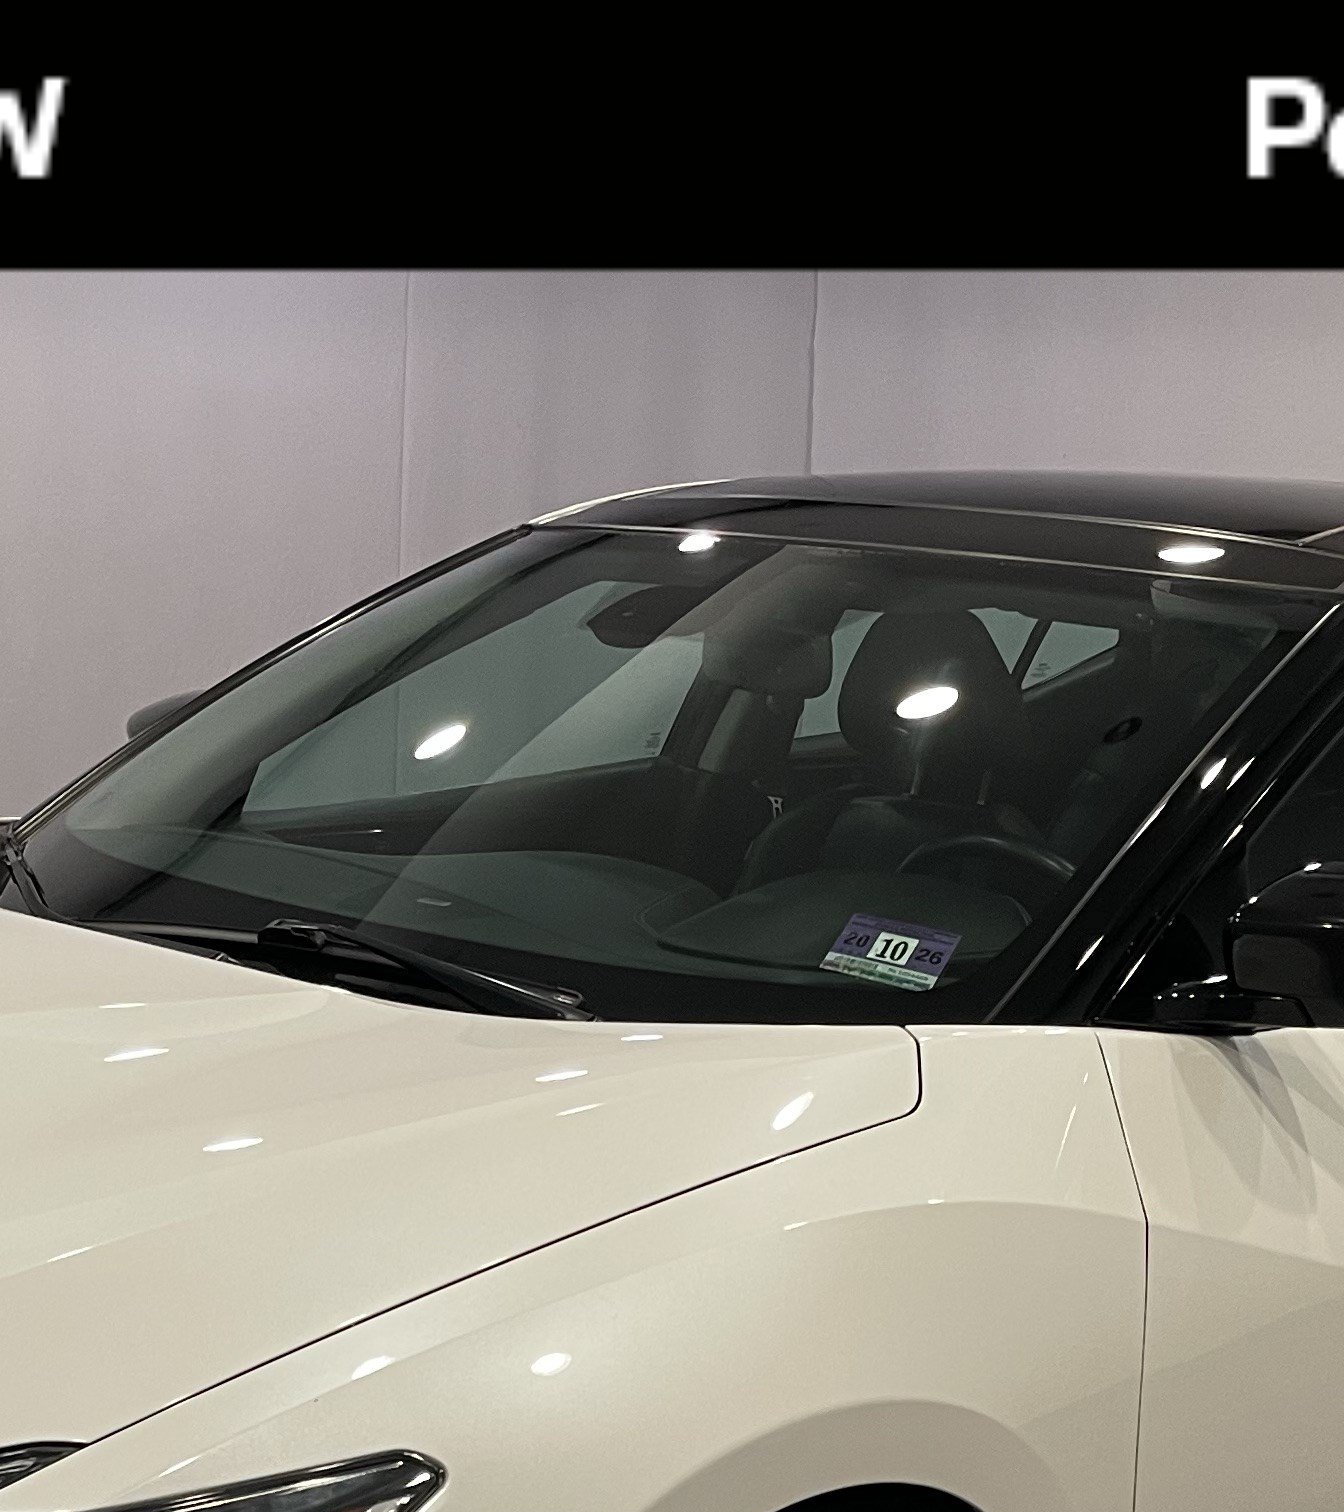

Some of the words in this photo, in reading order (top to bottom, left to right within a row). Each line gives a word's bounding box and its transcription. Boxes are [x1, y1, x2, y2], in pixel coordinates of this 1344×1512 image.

[843, 931, 870, 948] 20
[874, 938, 910, 962] 10
[914, 948, 944, 965] 26
